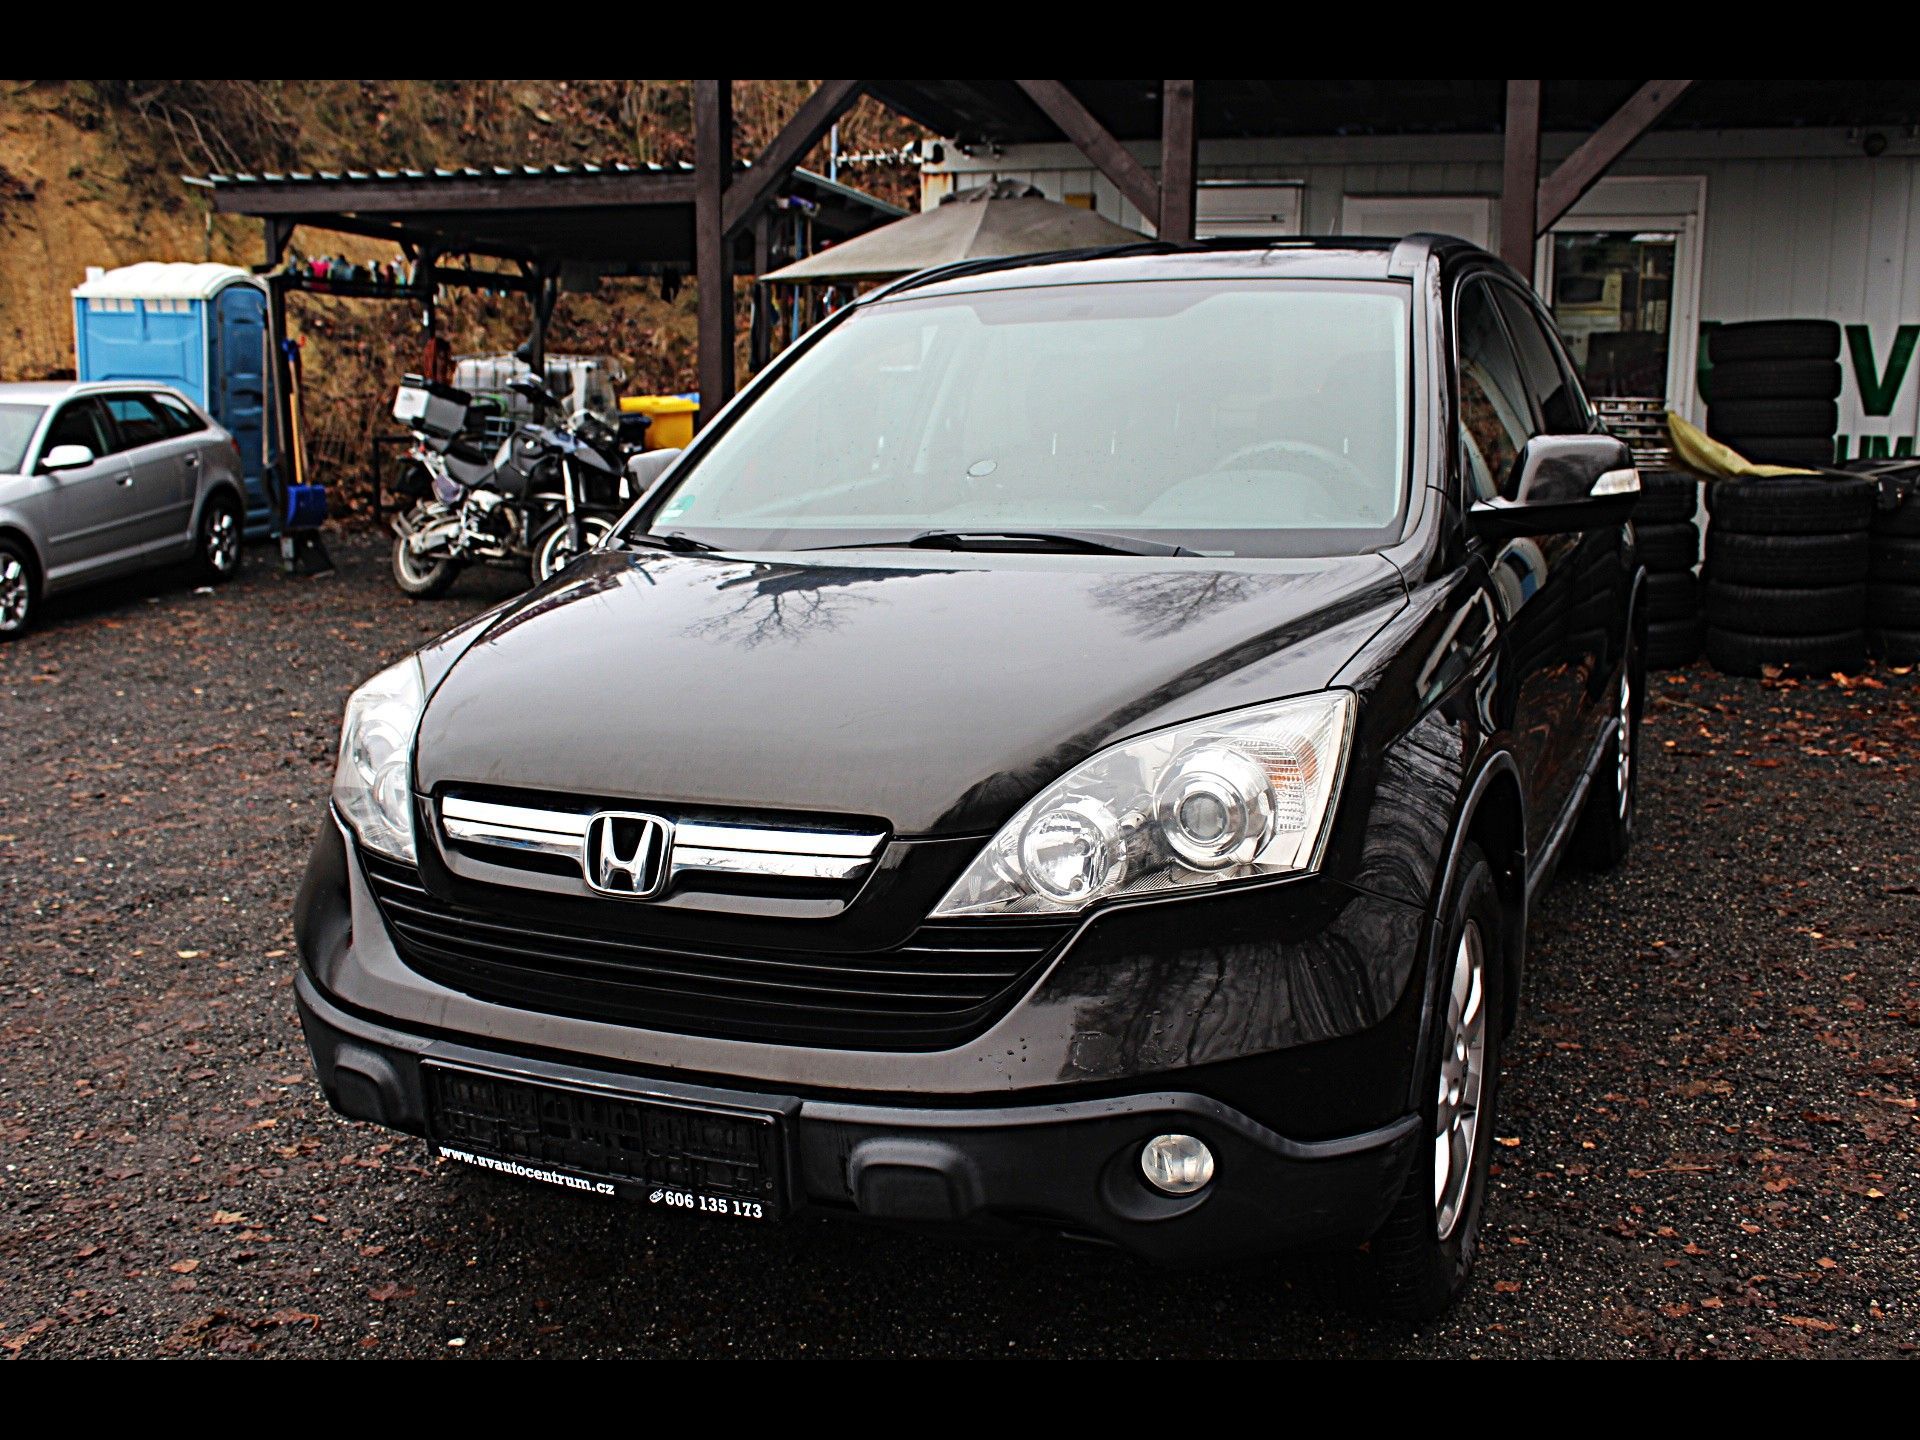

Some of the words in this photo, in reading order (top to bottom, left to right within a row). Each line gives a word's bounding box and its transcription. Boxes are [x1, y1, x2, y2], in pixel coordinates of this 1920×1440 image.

[438, 1146, 615, 1196] www.uvautocentrum.cz
[665, 1191, 694, 1209] 606
[699, 1195, 728, 1213] 135
[733, 1201, 763, 1219] 173
